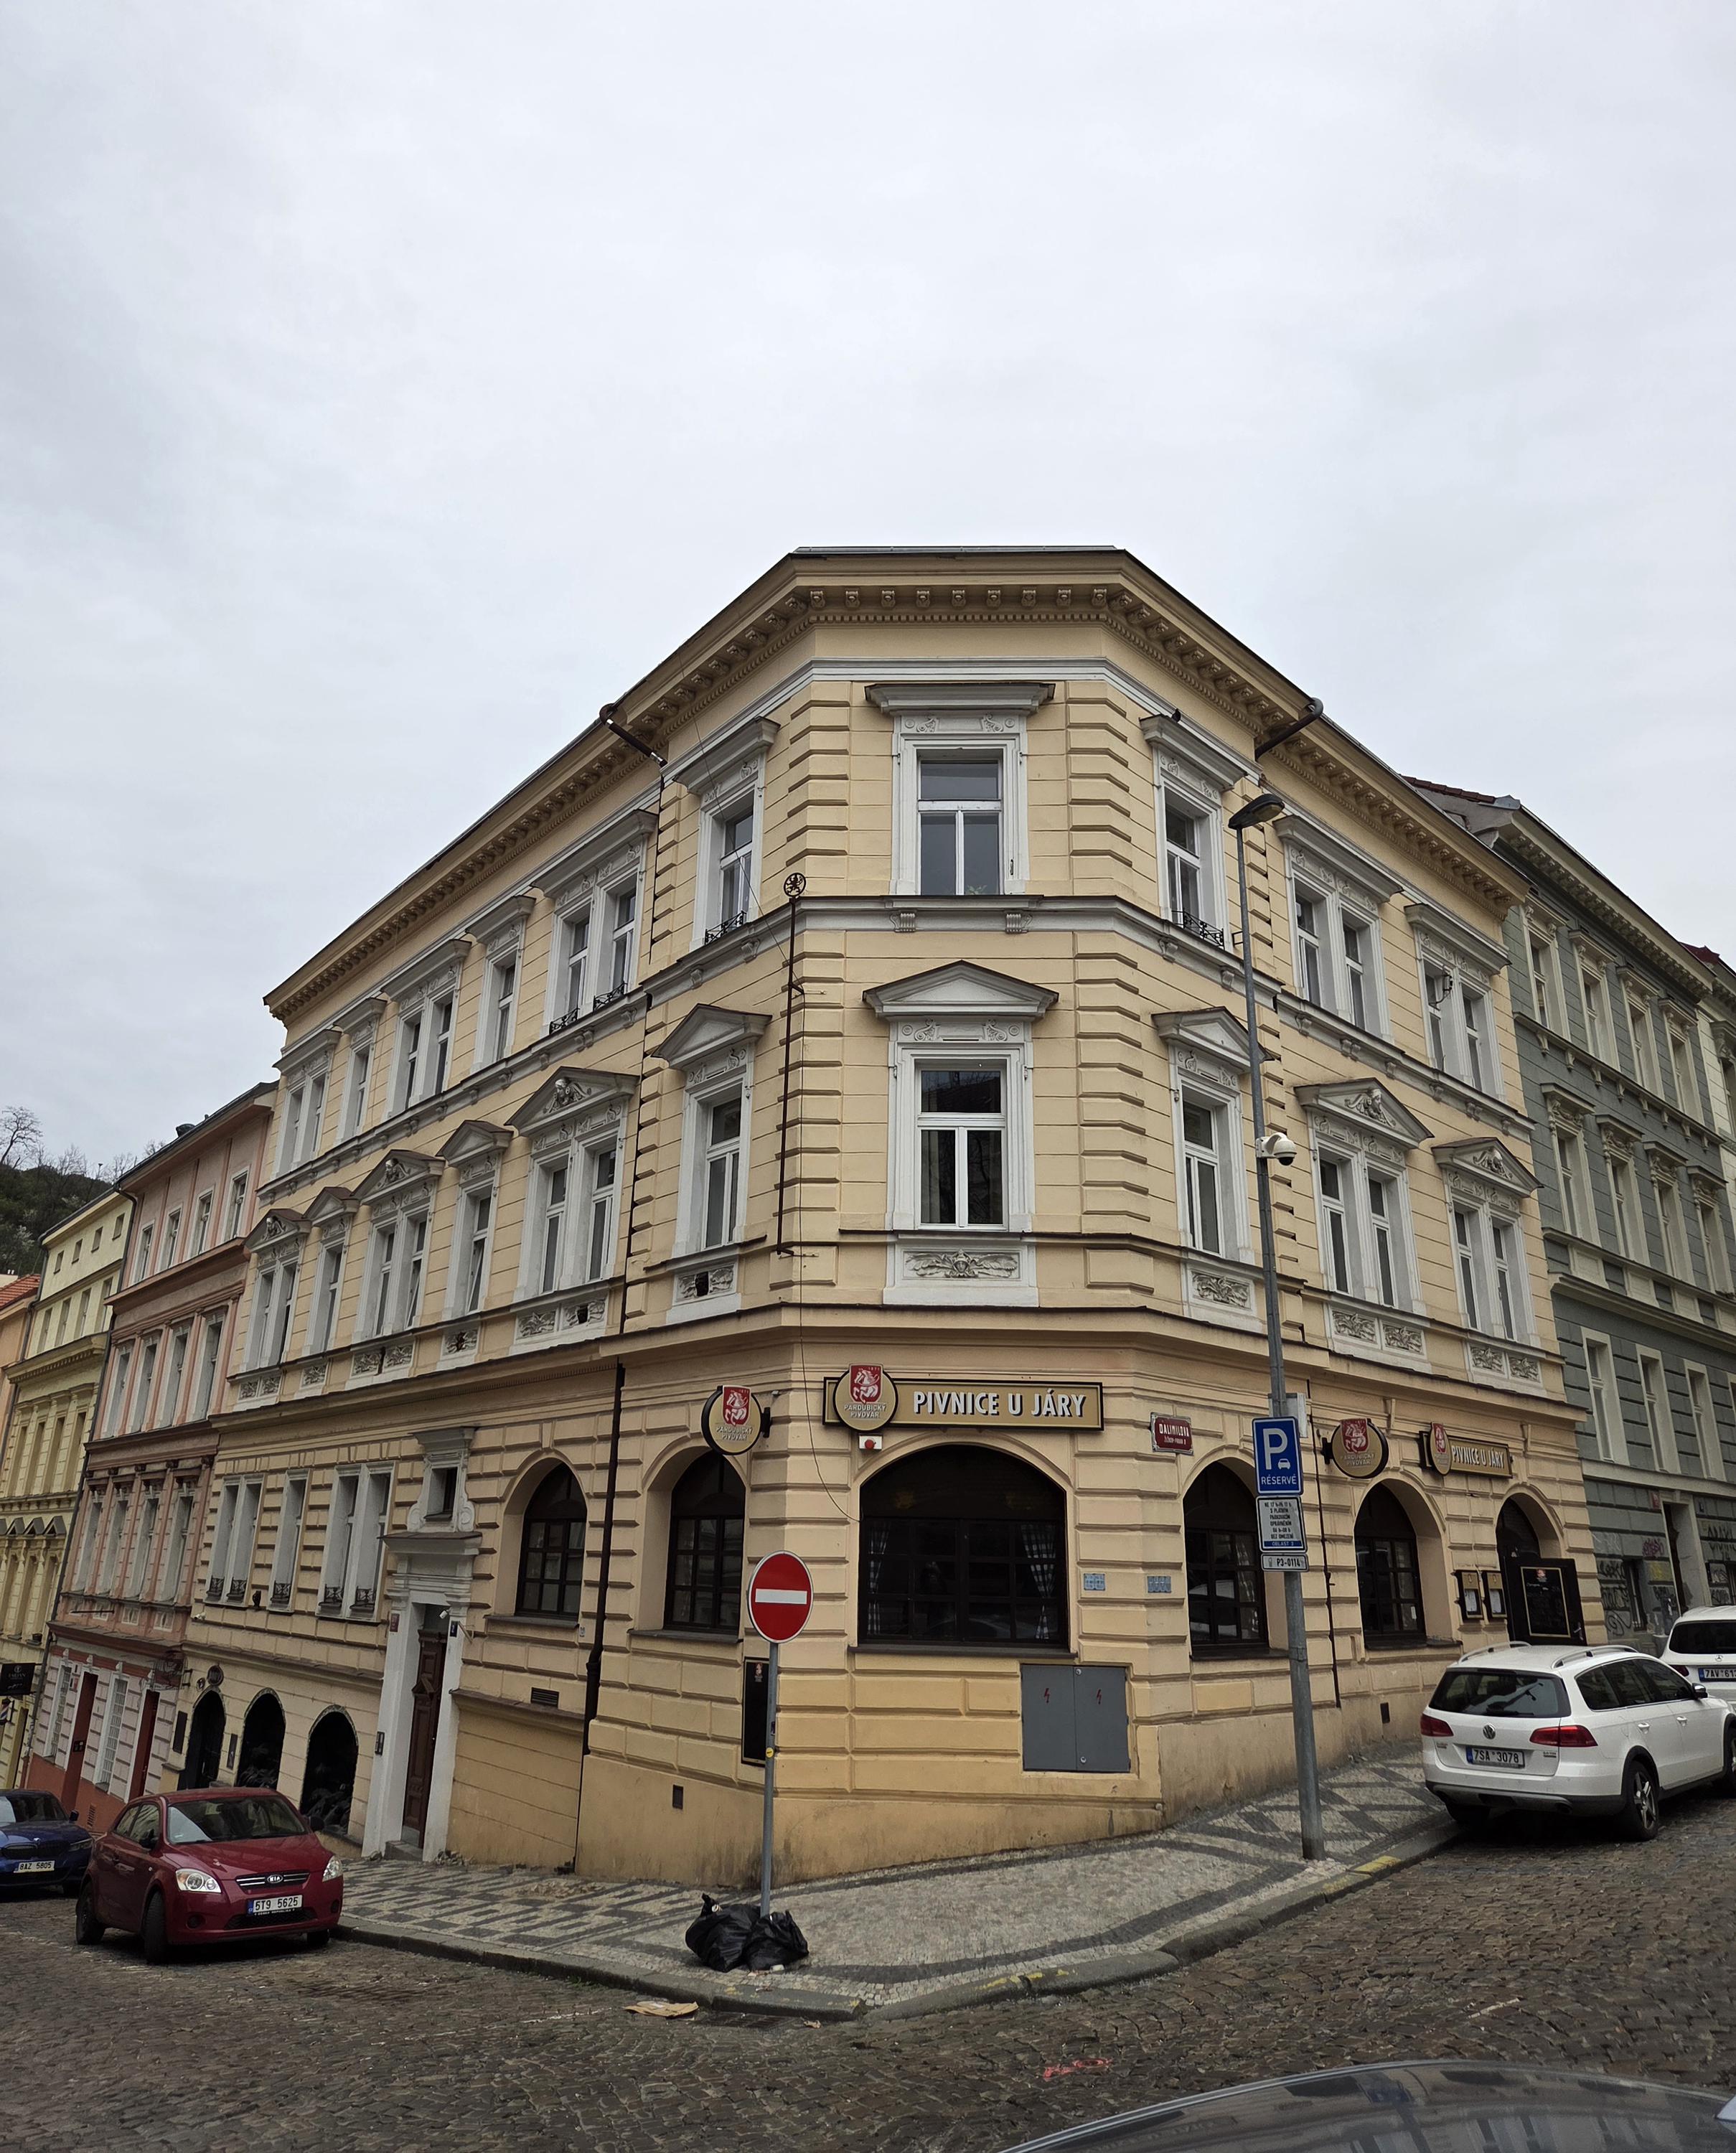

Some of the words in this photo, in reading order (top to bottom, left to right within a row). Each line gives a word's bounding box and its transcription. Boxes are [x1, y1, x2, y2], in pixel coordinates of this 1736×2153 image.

[844, 1403, 887, 1412] PARDUBICKÝ
[913, 1391, 1000, 1416] PIVNICE
[1008, 1393, 1023, 1417] U
[1031, 1388, 1087, 1417] JÁRY
[1263, 1427, 1288, 1470] P
[1451, 1445, 1481, 1465] PIVNICE
[1481, 1448, 1487, 1466] U
[1261, 1473, 1297, 1485] RÉSERVÉ
[1277, 1558, 1300, 1567] P3-0114
[1474, 1749, 1490, 1761] 7SA
[1497, 1751, 1519, 1763] 3078
[255, 1900, 271, 1910] 5T9
[277, 1897, 299, 1908] 5625
